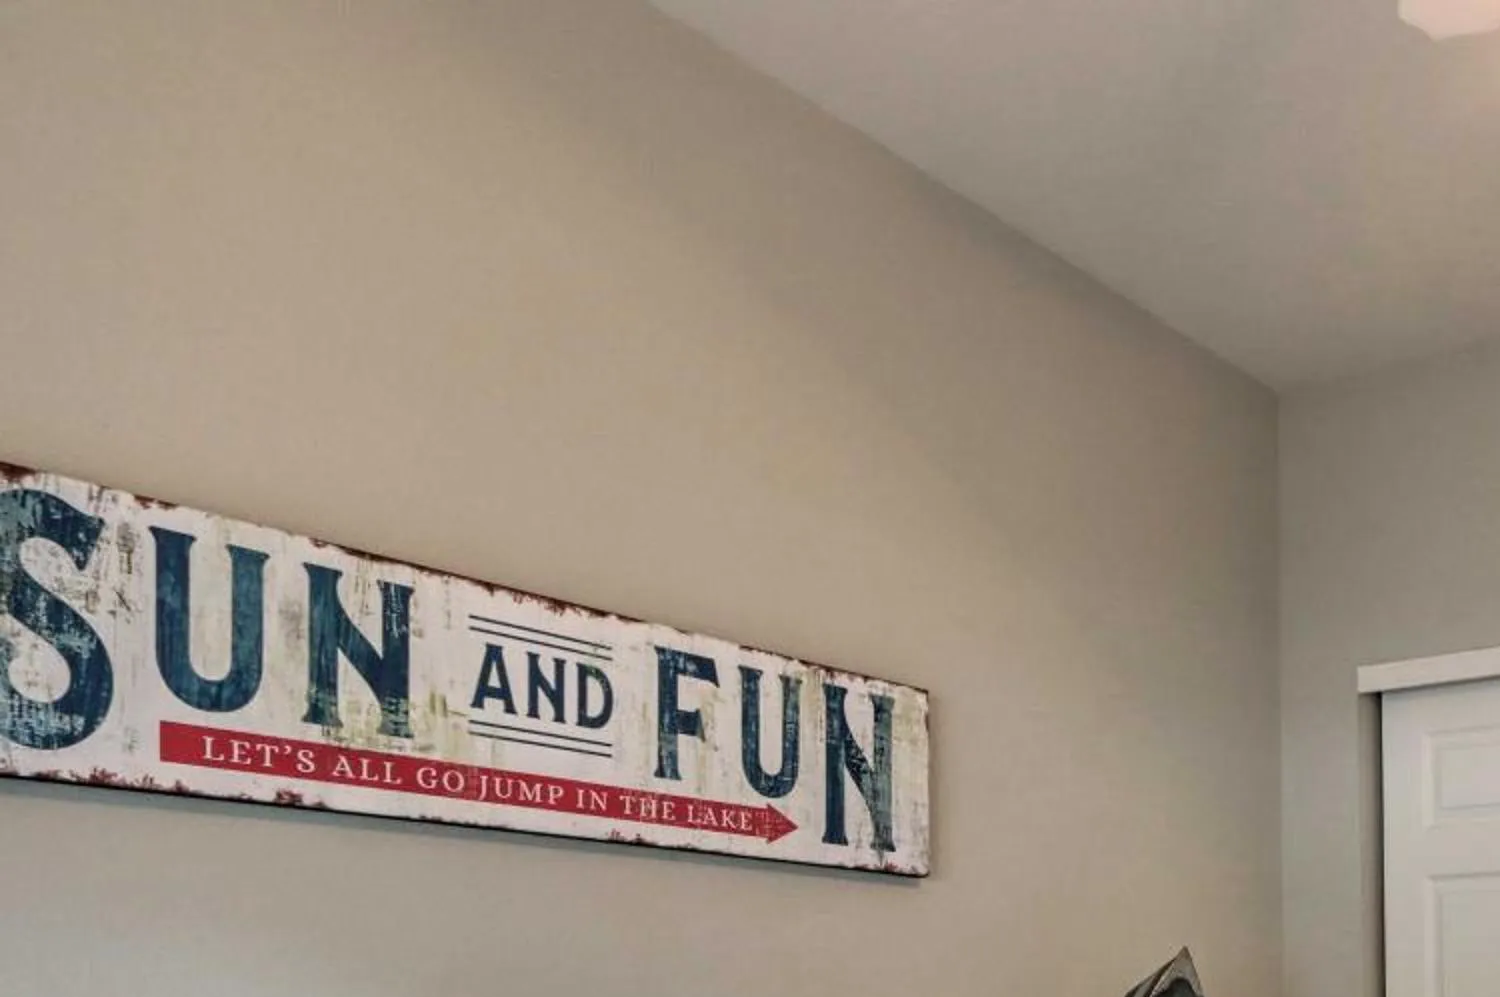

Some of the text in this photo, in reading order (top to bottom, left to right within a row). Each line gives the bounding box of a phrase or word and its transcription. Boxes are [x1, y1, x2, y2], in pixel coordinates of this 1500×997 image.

[0, 488, 896, 853] SUN AND FUN
[202, 735, 753, 831] LET'S ALL GO JUMP IN THE LAKE
